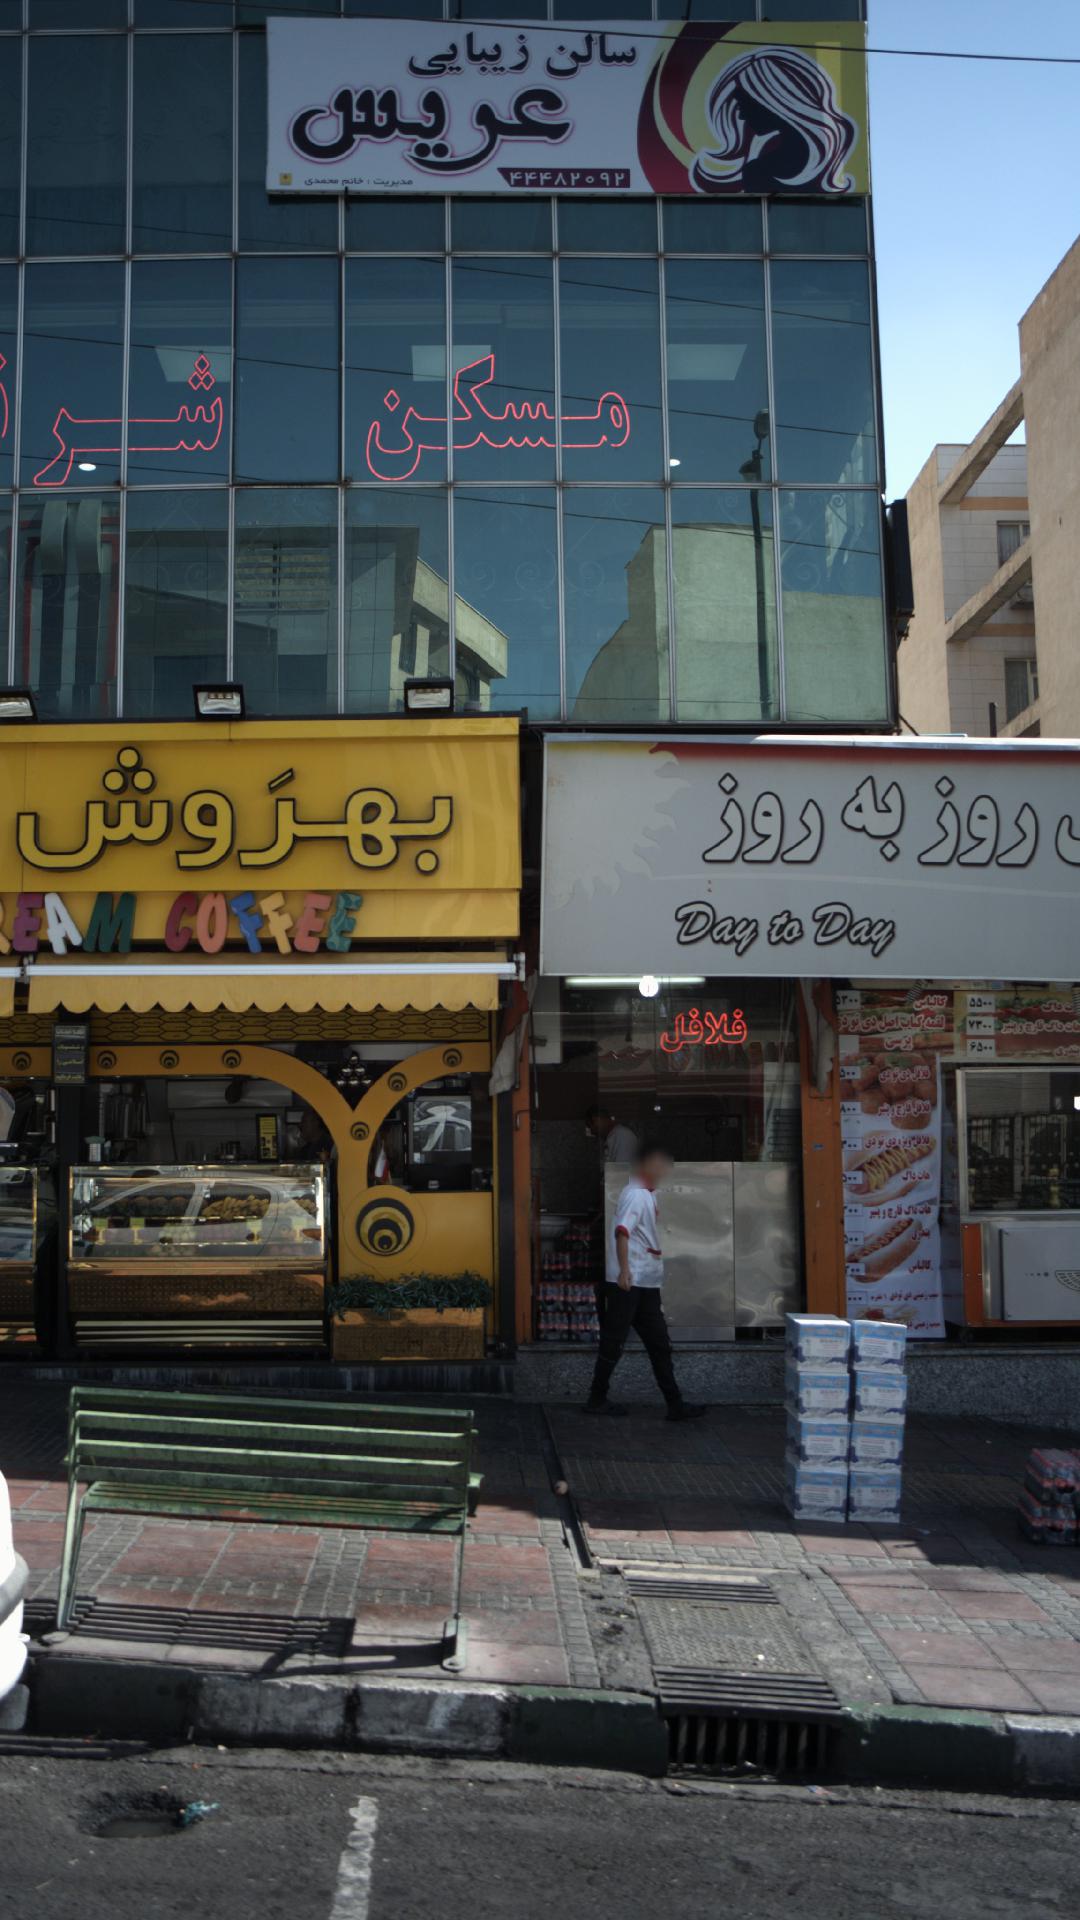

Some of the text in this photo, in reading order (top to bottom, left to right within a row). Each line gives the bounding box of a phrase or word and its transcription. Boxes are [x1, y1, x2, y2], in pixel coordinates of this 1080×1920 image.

[408, 31, 637, 78] سالن زیبایی
[304, 176, 339, 186] محمدی
[341, 176, 364, 187] خانم
[372, 176, 414, 188] مدیریت
[509, 171, 626, 187] ۴۴۴۸۲۰۹۲
[366, 353, 631, 481] مسکن
[702, 772, 824, 863] روز
[840, 775, 905, 862] به
[918, 775, 1039, 867] روز
[0, 891, 363, 955] EAM COFFEE
[674, 900, 896, 957] Day to Day
[913, 994, 948, 1011] کالباس
[969, 997, 993, 1008] ۵۵۰۰
[923, 1014, 946, 1029] لقمه
[659, 1008, 748, 1053] فلافل
[969, 1041, 993, 1052] ۶۵۰۰
[908, 1259, 932, 1274] کالباس
